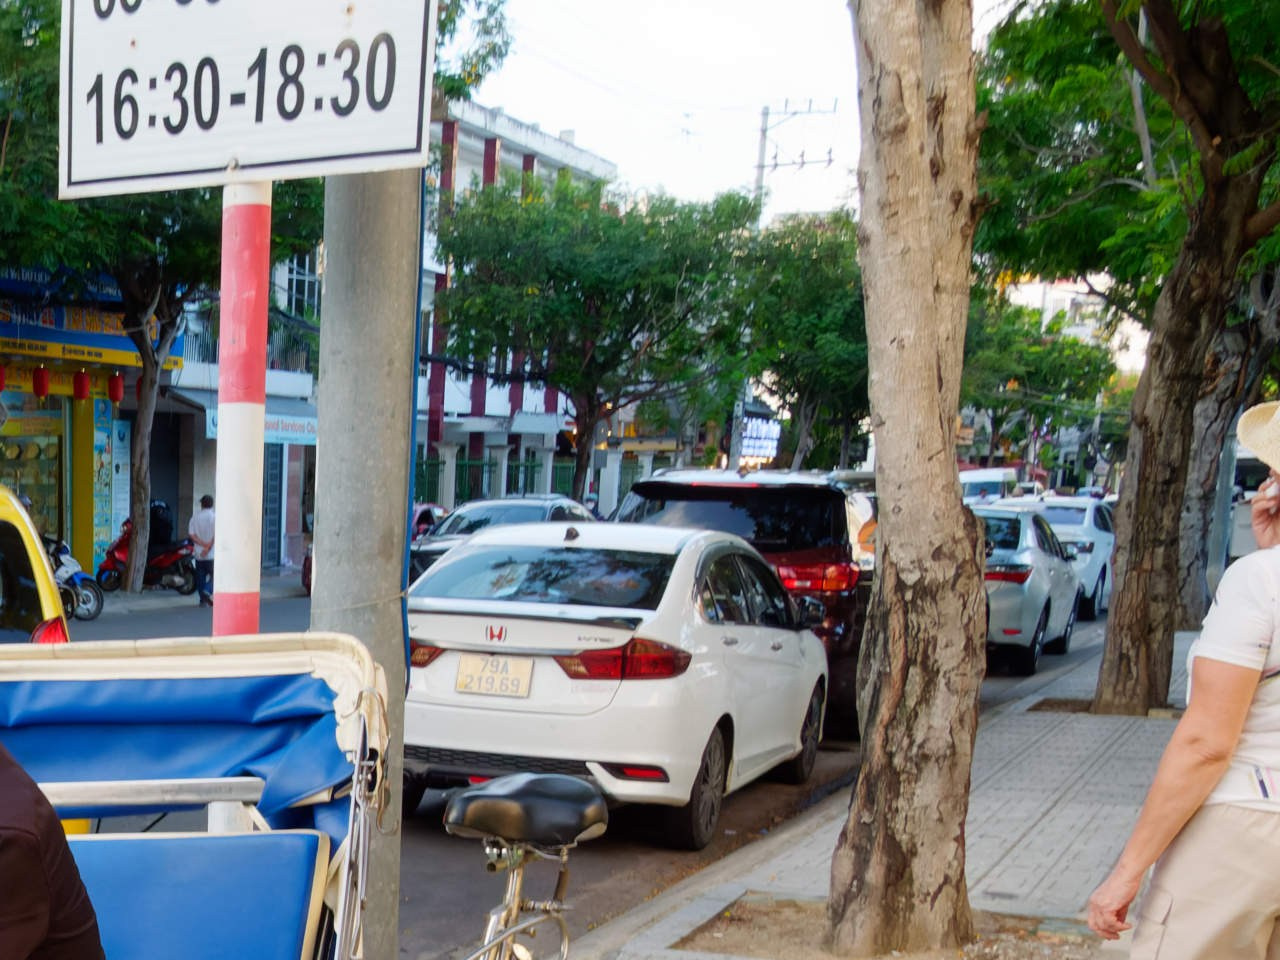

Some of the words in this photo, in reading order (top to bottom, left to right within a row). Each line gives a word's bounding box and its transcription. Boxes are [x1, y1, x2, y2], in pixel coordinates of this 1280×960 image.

[86, 32, 397, 144] 16:30-18:30
[480, 657, 509, 675] 79A
[463, 674, 521, 694] 219.69
